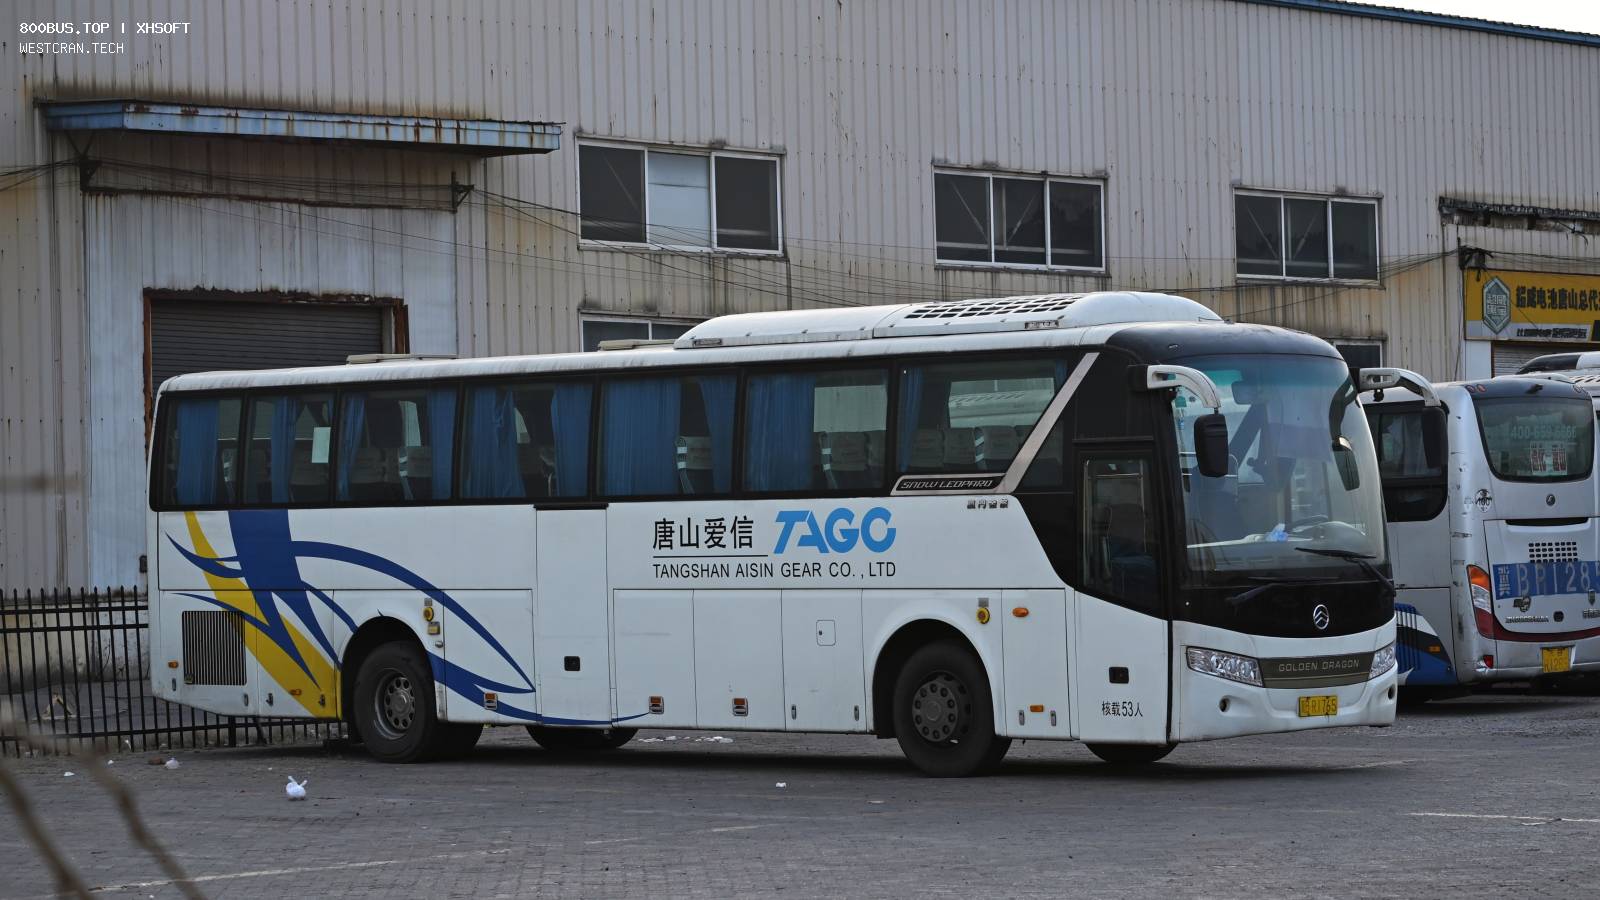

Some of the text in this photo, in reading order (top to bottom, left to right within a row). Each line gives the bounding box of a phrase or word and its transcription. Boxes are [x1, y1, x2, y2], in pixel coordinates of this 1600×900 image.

[901, 480, 993, 489] SNOW LEOPARD
[653, 516, 754, 550] 唐山爱信
[653, 563, 729, 578] TANGSHAN
[736, 563, 774, 578] AISIN
[781, 562, 821, 577] GEAR
[1279, 659, 1359, 672] GOLDEN DRAGON
[1102, 701, 1143, 718] 核载53人
